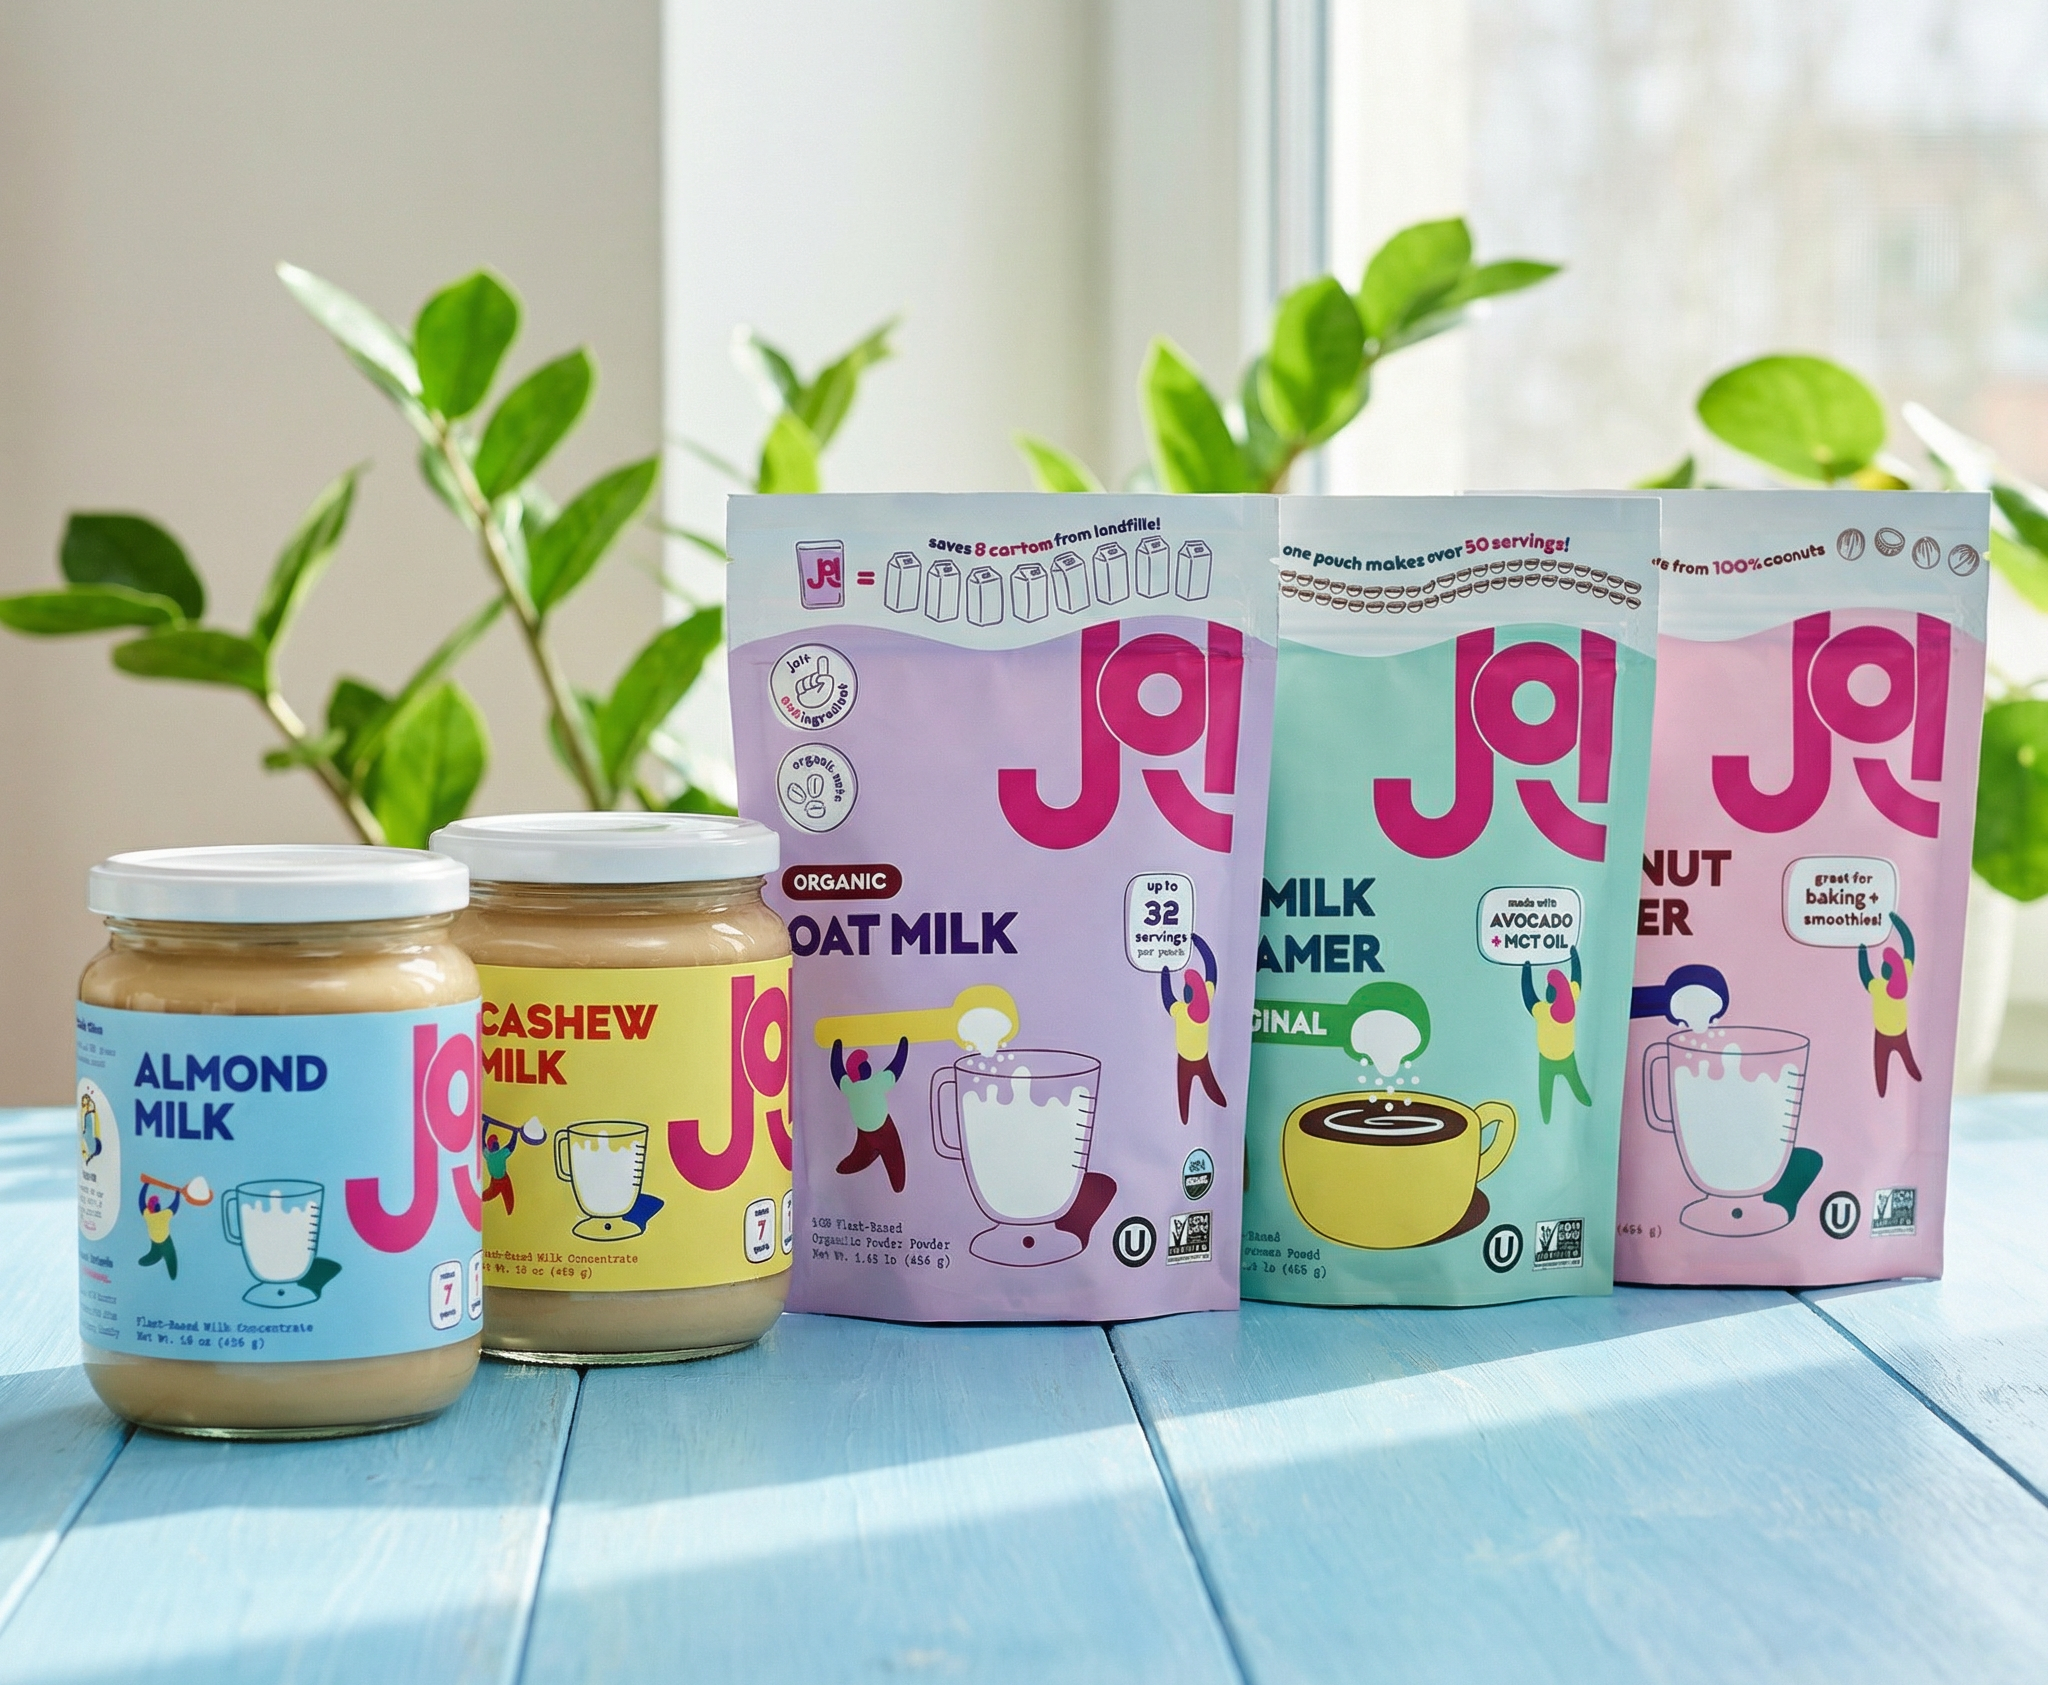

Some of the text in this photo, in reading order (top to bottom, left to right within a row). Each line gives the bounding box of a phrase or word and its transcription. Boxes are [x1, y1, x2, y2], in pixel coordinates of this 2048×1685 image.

[928, 538, 972, 555] saves
[974, 542, 987, 557] 8
[1054, 528, 1092, 547] from
[1283, 545, 1312, 560] one
[1313, 553, 1362, 570] pouch
[1465, 537, 1489, 554] 50
[1673, 559, 1709, 575] from
[1712, 558, 1763, 575] 100%
[793, 872, 887, 891] ORGANIC
[1642, 849, 1732, 887] NUT
[1852, 871, 1873, 884] for
[1147, 880, 1178, 894] up to
[1260, 878, 1376, 917] MILK
[1806, 888, 1866, 910] baking
[1143, 900, 1179, 926] 32
[1490, 913, 1573, 928] AVOCADO
[1637, 899, 1694, 936] ER
[787, 912, 1019, 956] OAT MILK
[1135, 930, 1187, 946] servings
[1505, 934, 1541, 949] MCT
[1543, 934, 1568, 949] OIL
[481, 1001, 658, 1040] CASHEW
[134, 1051, 328, 1093] ALMOND
[481, 1048, 567, 1085] MILK
[134, 1098, 235, 1141] MILK
[757, 1219, 767, 1241] 7
